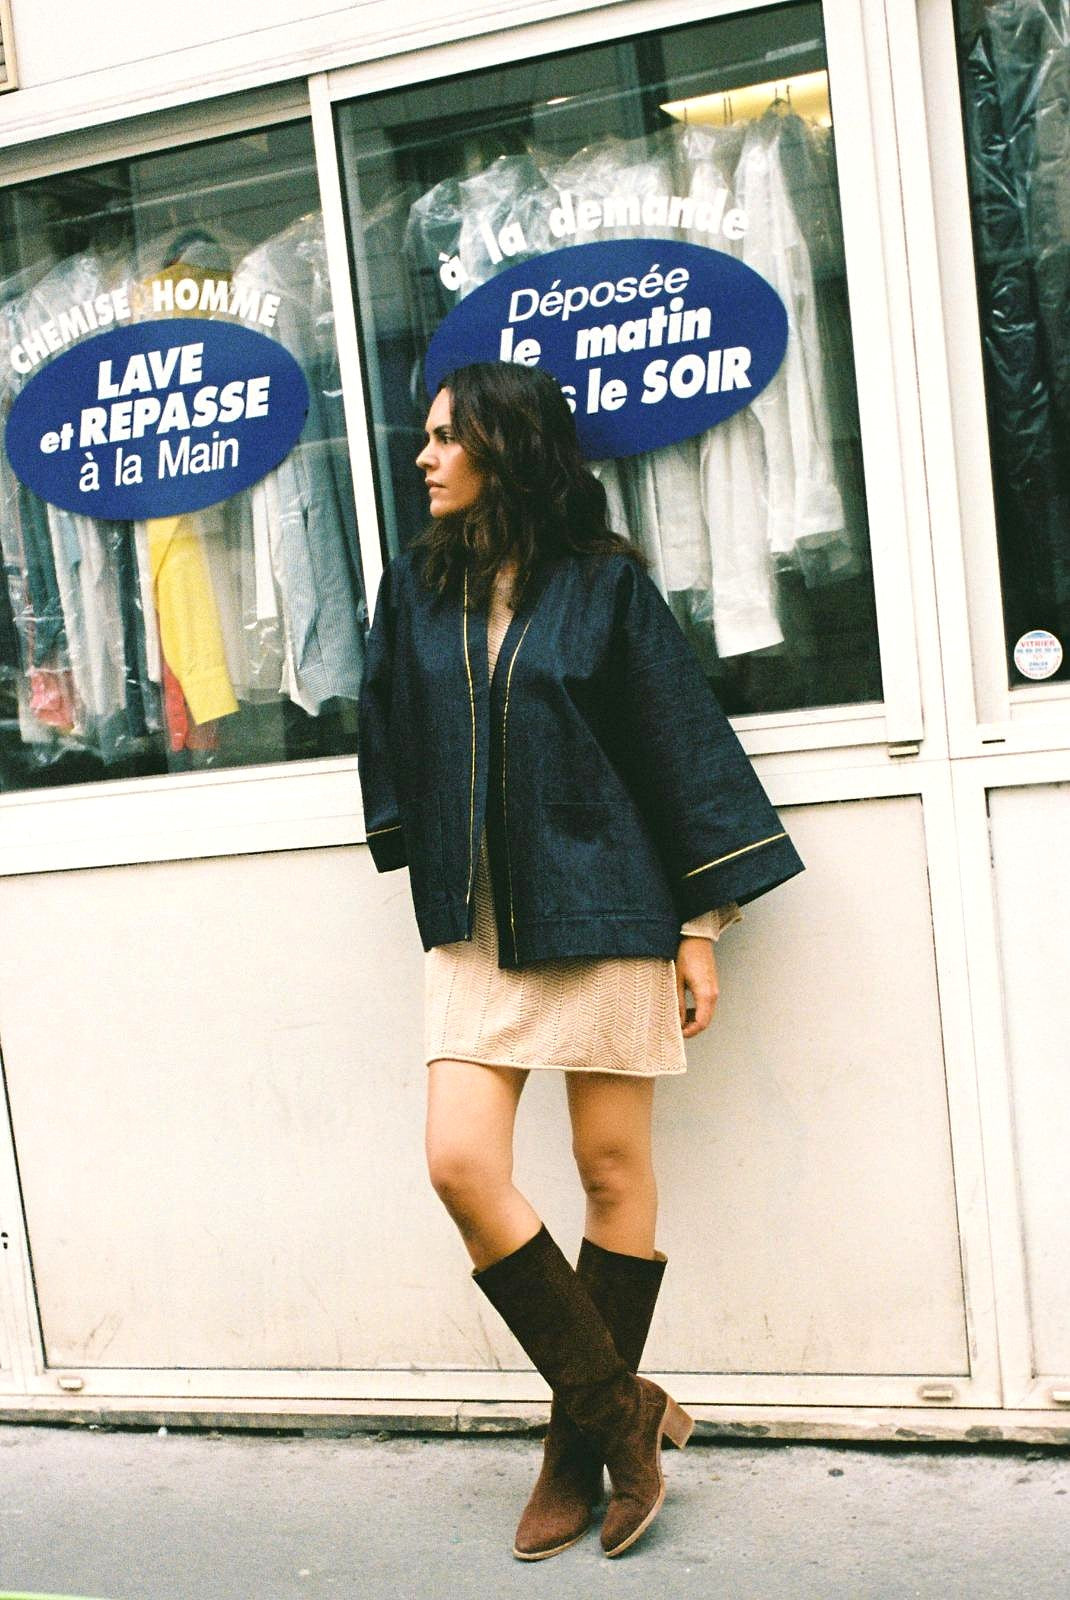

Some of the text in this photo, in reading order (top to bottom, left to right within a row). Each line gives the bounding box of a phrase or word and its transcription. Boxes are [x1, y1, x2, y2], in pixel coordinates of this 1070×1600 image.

[439, 190, 749, 291] à la demande
[12, 278, 281, 374] CHEMISE HOMME
[508, 264, 690, 323] Déposée
[500, 297, 711, 367] le matin
[97, 342, 204, 400] LAVE
[586, 367, 627, 415] le
[641, 346, 752, 404] SOIR
[40, 376, 270, 453] et REPASSE
[79, 431, 239, 492] à la Main
